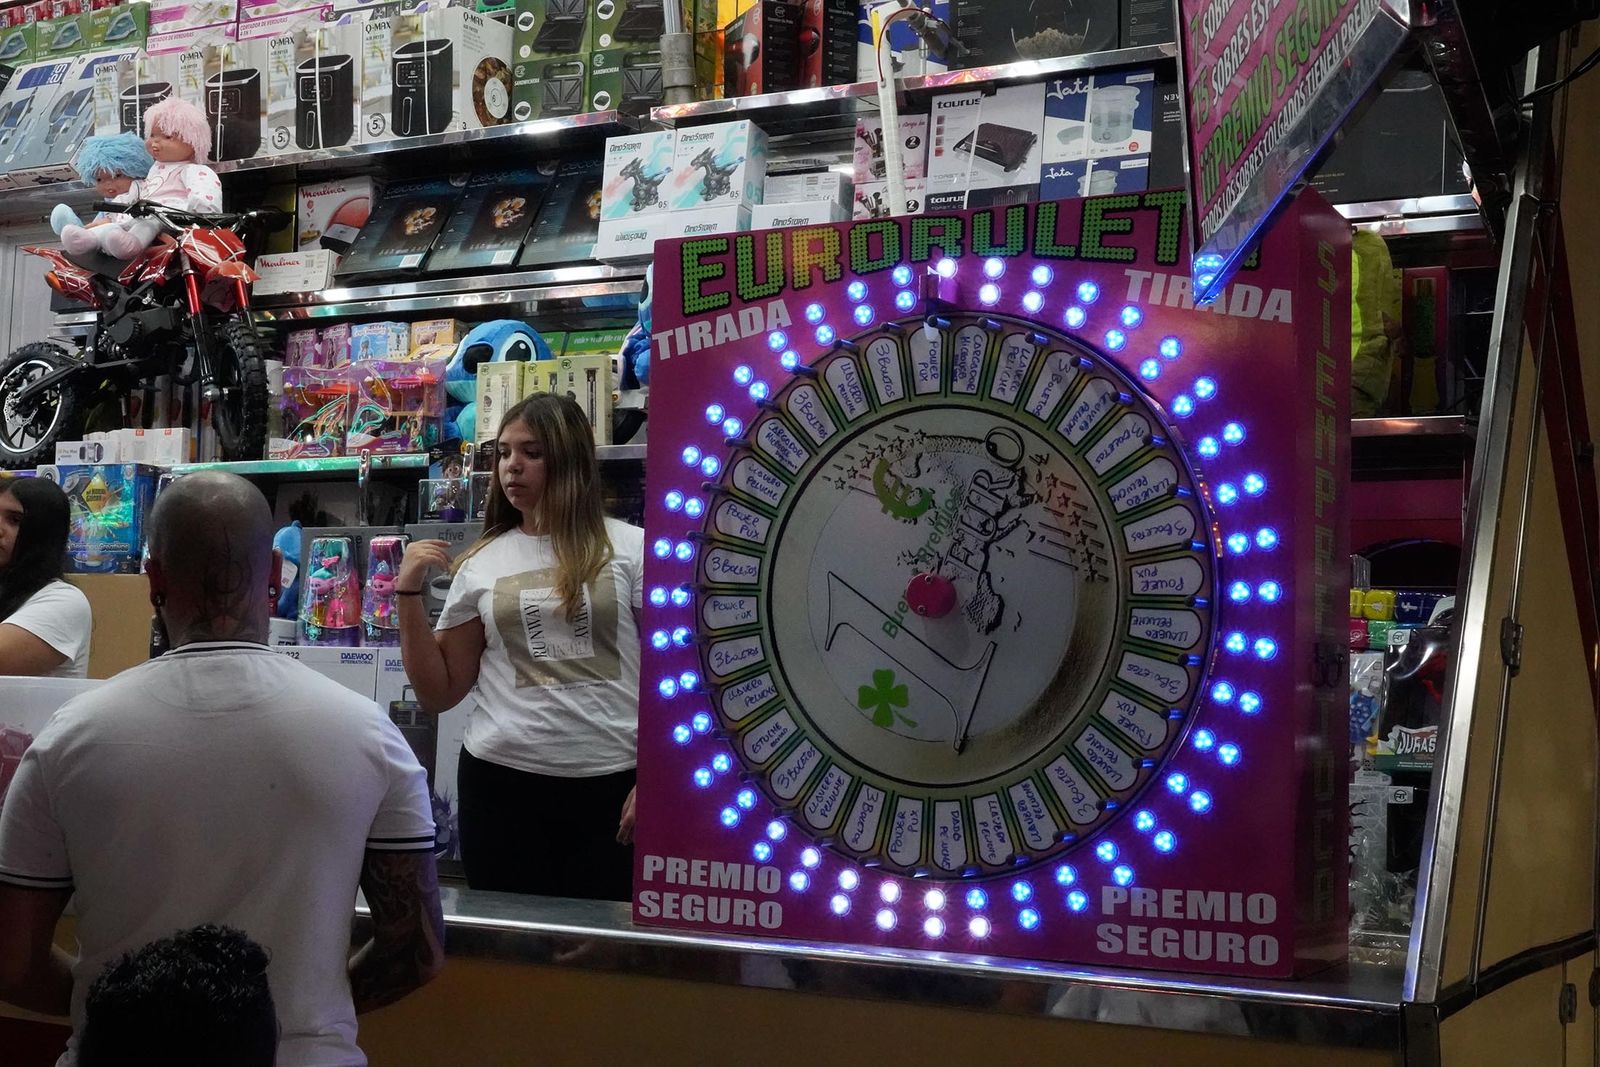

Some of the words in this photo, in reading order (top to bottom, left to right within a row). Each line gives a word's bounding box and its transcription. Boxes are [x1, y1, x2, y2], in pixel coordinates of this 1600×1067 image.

[365, 21, 391, 34] Q-MAX
[463, 11, 484, 27] Q-MAX
[270, 36, 295, 49] Q-MAX
[1274, 0, 1348, 98] SEGU
[180, 52, 204, 63] Q-MAX
[95, 65, 118, 76] Q-MAX
[1193, 67, 1210, 133] 15
[1212, 13, 1251, 106] SOBRES
[1047, 77, 1099, 100] Jata
[937, 99, 980, 109] taurus
[1201, 197, 1223, 242] TODOS
[1235, 139, 1264, 198] SOBRES
[1263, 82, 1307, 158] COLGADOS
[1306, 33, 1341, 96] TIENEN
[1045, 167, 1074, 179] Jata
[302, 185, 347, 199] Moulinex
[260, 256, 300, 268] Moulinex
[681, 191, 1259, 315] EURORULET
[1124, 267, 1294, 325] TIRADA
[652, 299, 793, 361] TIRADA
[876, 344, 889, 356] 3
[929, 342, 941, 380] POWER
[918, 363, 928, 381] PUX
[967, 334, 983, 391] CARGADOR
[1058, 359, 1074, 373] 3
[840, 363, 864, 404] LLAVERO
[878, 357, 895, 397] BOLETOS
[794, 391, 809, 404] 3
[1030, 373, 1063, 419] BOLETOS
[1132, 423, 1144, 438] 3
[1127, 478, 1173, 506] LLAVERO
[726, 504, 759, 527] POWER
[740, 525, 759, 539] PUX
[1131, 523, 1172, 541] BOLETOS
[1174, 521, 1187, 535] 3
[712, 557, 720, 571] 3
[1136, 566, 1158, 578] PUX
[1141, 577, 1184, 592] POWER
[1130, 616, 1172, 627] PELUCHE
[385, 659, 404, 667] DAE
[715, 652, 724, 668] 3
[728, 679, 762, 700] LLAVERO
[1169, 680, 1180, 694] 3
[752, 722, 781, 753] ESTUCHE
[1086, 734, 1118, 763] PELUCHE
[1398, 730, 1436, 753] JURAS
[777, 774, 789, 789] 3
[787, 746, 815, 781] BOLETOS
[1087, 748, 1122, 782] LLAVERO
[809, 773, 833, 813] LLAVERO
[820, 776, 844, 817] PELUCHE
[867, 788, 878, 802] 3
[1022, 784, 1045, 819] PELUCHE
[907, 810, 918, 832] PUX
[1077, 803, 1095, 816] 3
[890, 812, 906, 853] POWER
[951, 809, 961, 841] DADO
[940, 826, 950, 869] PEUCHE
[642, 855, 782, 894] PREMIO
[638, 890, 783, 929] SEGURO
[1102, 885, 1278, 925] PREMIO
[1097, 922, 1279, 966] SEGURO
